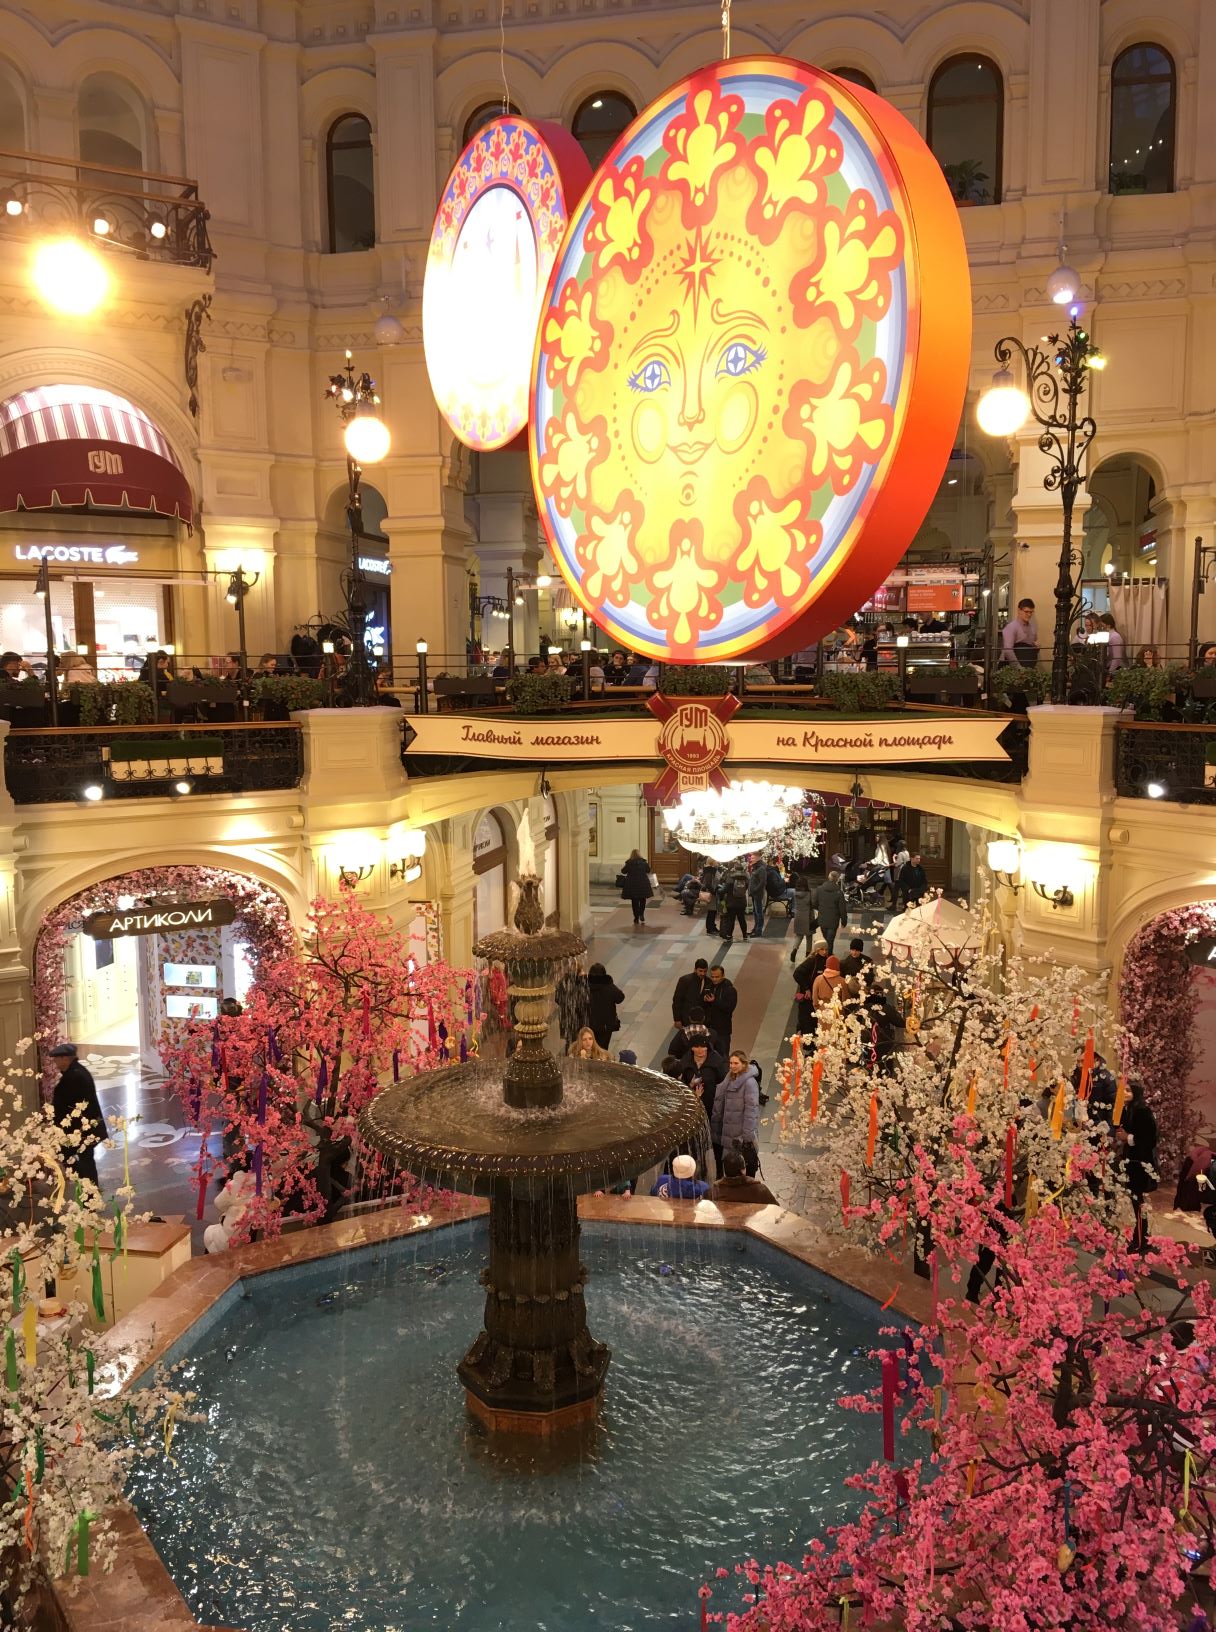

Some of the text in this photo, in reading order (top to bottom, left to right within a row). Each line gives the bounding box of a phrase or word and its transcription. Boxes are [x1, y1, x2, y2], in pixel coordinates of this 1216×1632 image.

[15, 545, 104, 562] LACOSTE
[679, 706, 709, 729] ГУМ
[461, 725, 601, 746] Главный магазин
[776, 731, 954, 752] на Красной площади
[681, 775, 704, 786] GUM
[109, 908, 213, 932] АРТИКОЛИ
